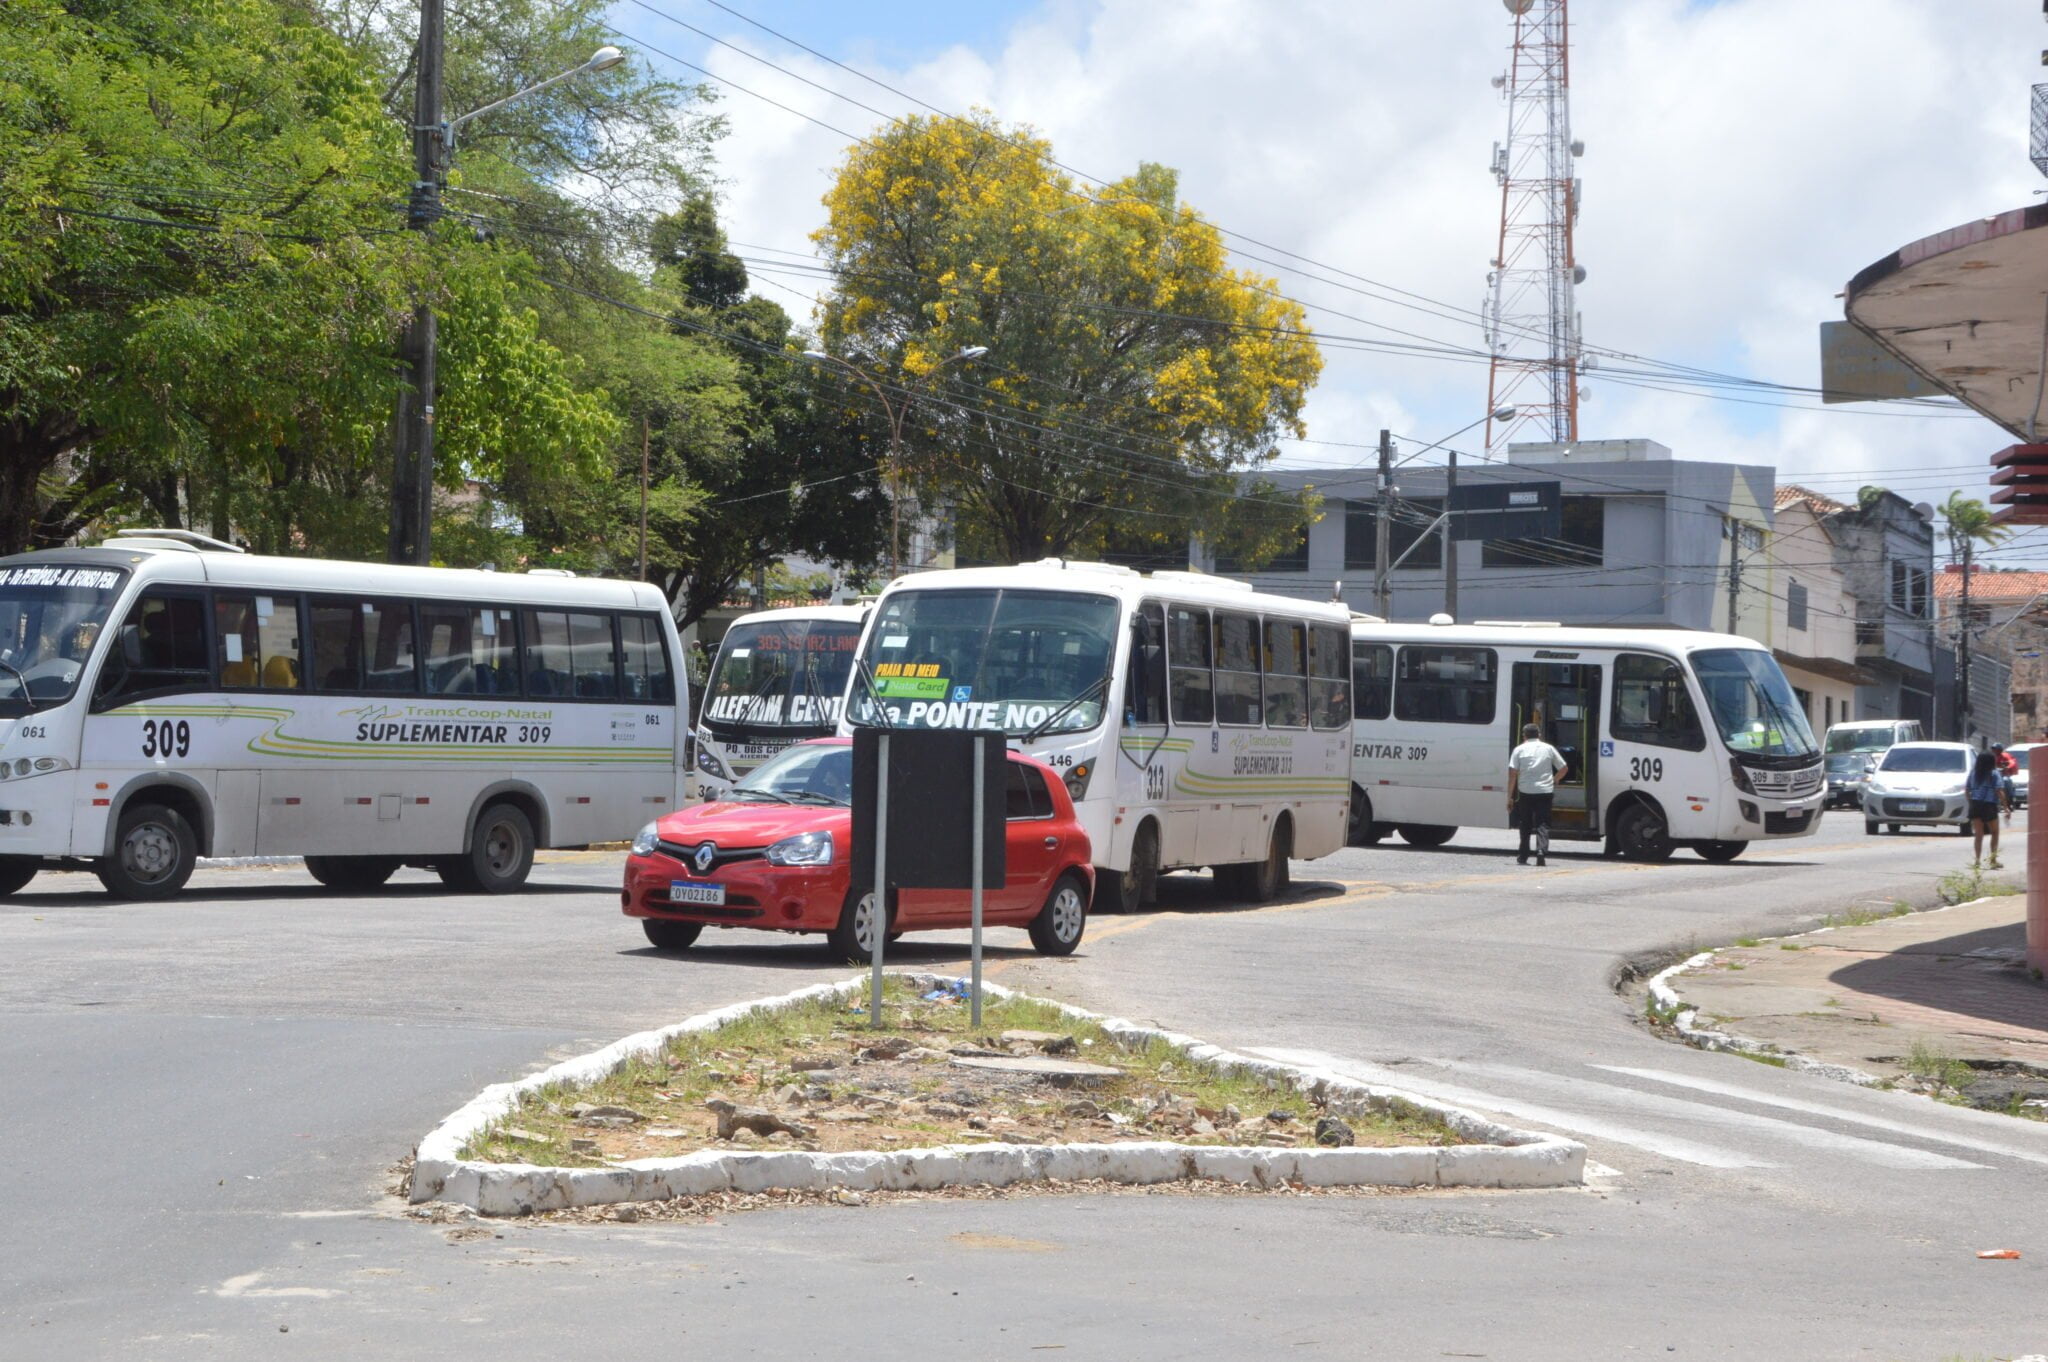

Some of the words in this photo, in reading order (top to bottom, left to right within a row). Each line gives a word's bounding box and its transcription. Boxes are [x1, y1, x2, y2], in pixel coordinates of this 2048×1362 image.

[68, 570, 102, 588] AFONSO
[875, 663, 902, 677] PRAIA
[902, 663, 917, 677] DO
[916, 663, 940, 678] MEIO
[405, 706, 553, 720] TransCoop-Natal
[645, 714, 660, 725] 061
[906, 701, 1000, 729] PONTE
[1003, 703, 1085, 729] NOVA
[22, 726, 46, 739] 061
[142, 719, 190, 758] 309
[356, 722, 508, 744] SUPLEMENTAR
[518, 725, 552, 744] 309
[744, 745, 763, 754] DOS
[1407, 746, 1428, 761] 309
[1049, 755, 1073, 767] 146
[1233, 755, 1280, 775] SUPLEMENTAR
[1280, 756, 1293, 775] 313
[1630, 756, 1663, 782] 309
[1147, 765, 1164, 800] 313
[1752, 771, 1768, 783] 309
